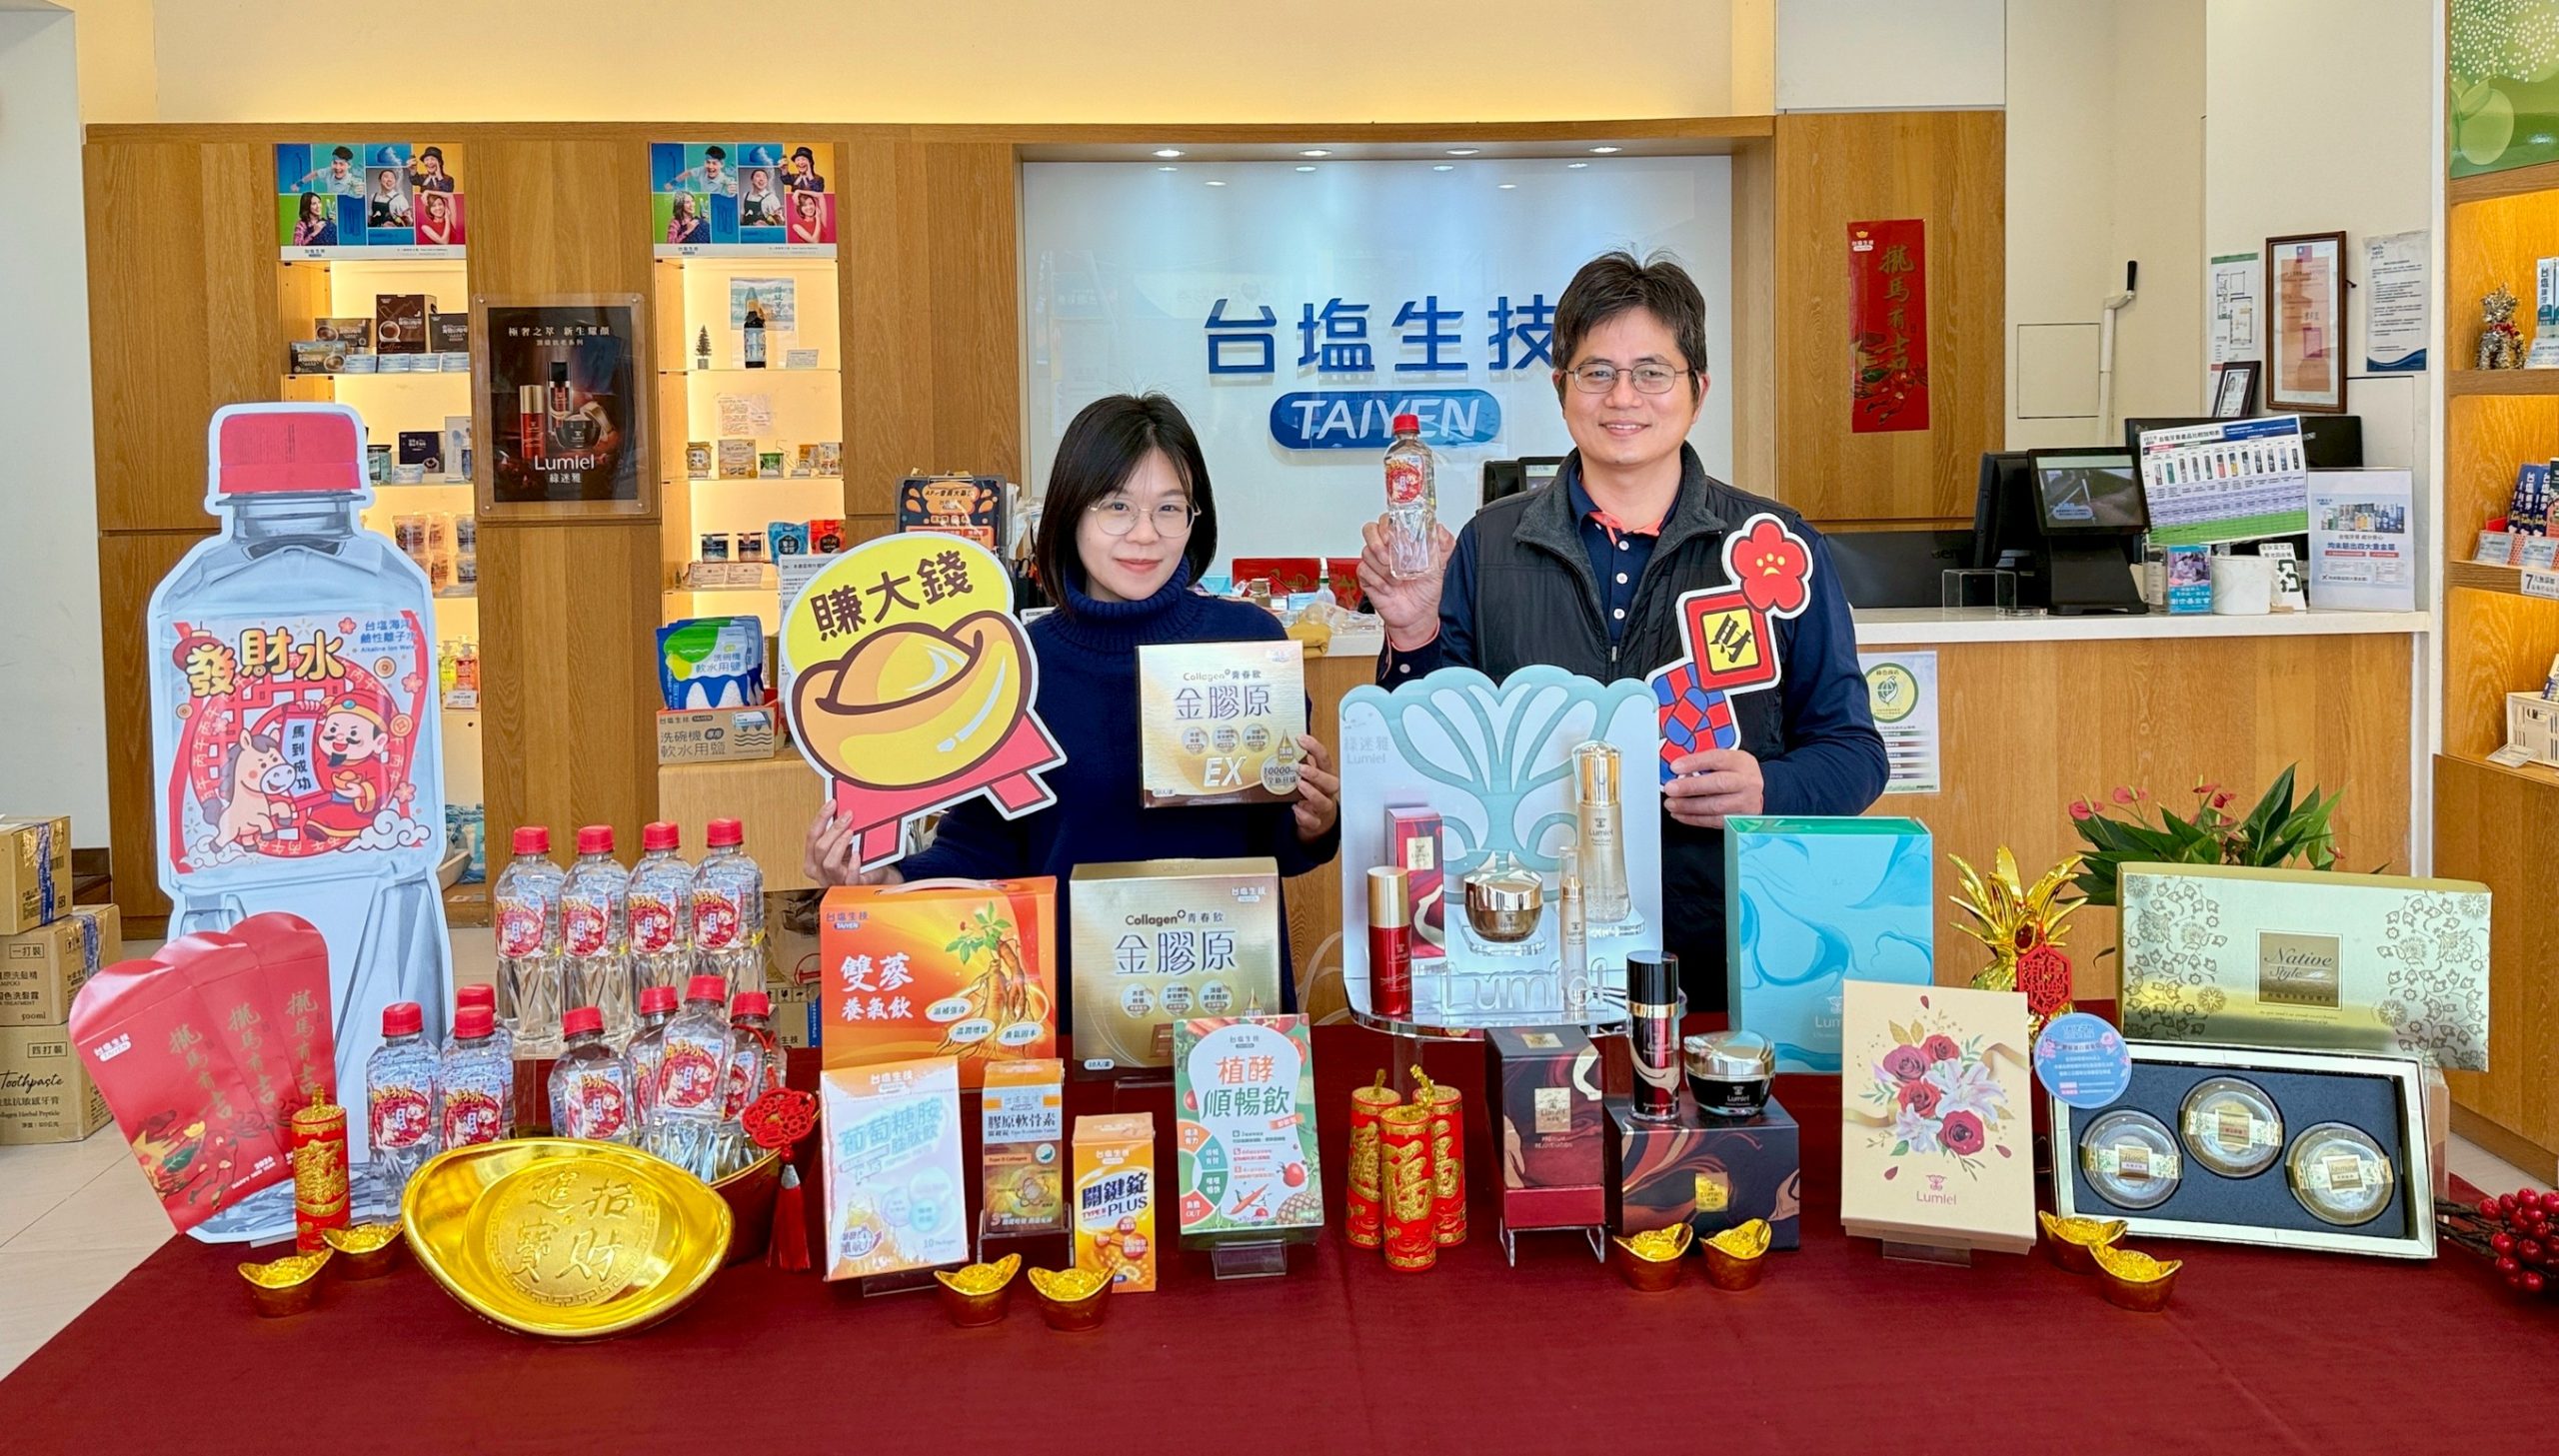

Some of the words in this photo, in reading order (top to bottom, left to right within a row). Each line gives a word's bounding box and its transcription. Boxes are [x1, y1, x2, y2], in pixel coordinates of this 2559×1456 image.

[1205, 295, 1556, 374] 台塩生技
[1290, 398, 1480, 441] TAIYEN
[534, 455, 596, 472] Lumiel
[809, 550, 975, 643] 賺大錢
[1708, 613, 1753, 665] 財
[186, 626, 347, 698] 發財水
[1173, 684, 1273, 722] 金膠原
[660, 730, 702, 743] 洗碗機
[660, 741, 727, 758] 軟水用鹽
[290, 724, 313, 791] 馬到成功
[1202, 755, 1248, 787] EX
[1345, 752, 1386, 765] Lumiel
[1587, 827, 1614, 837] Lumiel
[1125, 914, 1179, 927] Collagen
[1188, 911, 1225, 923] 青春飲
[1114, 929, 1238, 977] 金膠原
[2263, 947, 2332, 967] Native
[840, 951, 915, 993] 雙蔘
[2269, 965, 2303, 982] Style
[1443, 959, 1609, 1014] Lumiel
[21, 1011, 46, 1020] 500ml
[840, 995, 915, 1022] 養氣飲
[1814, 1015, 1843, 1029] Lum
[0, 1069, 65, 1094] Toothpaste
[1215, 1054, 1276, 1085] 植酵
[1201, 1085, 1291, 1119] 順暢飲
[1726, 1093, 1750, 1103] Lumiel
[1082, 1170, 1149, 1210] 關鍵錠
[1915, 1189, 1958, 1206] Lumiel
[1108, 1195, 1149, 1217] PLUS
[555, 1177, 636, 1283] 招財
